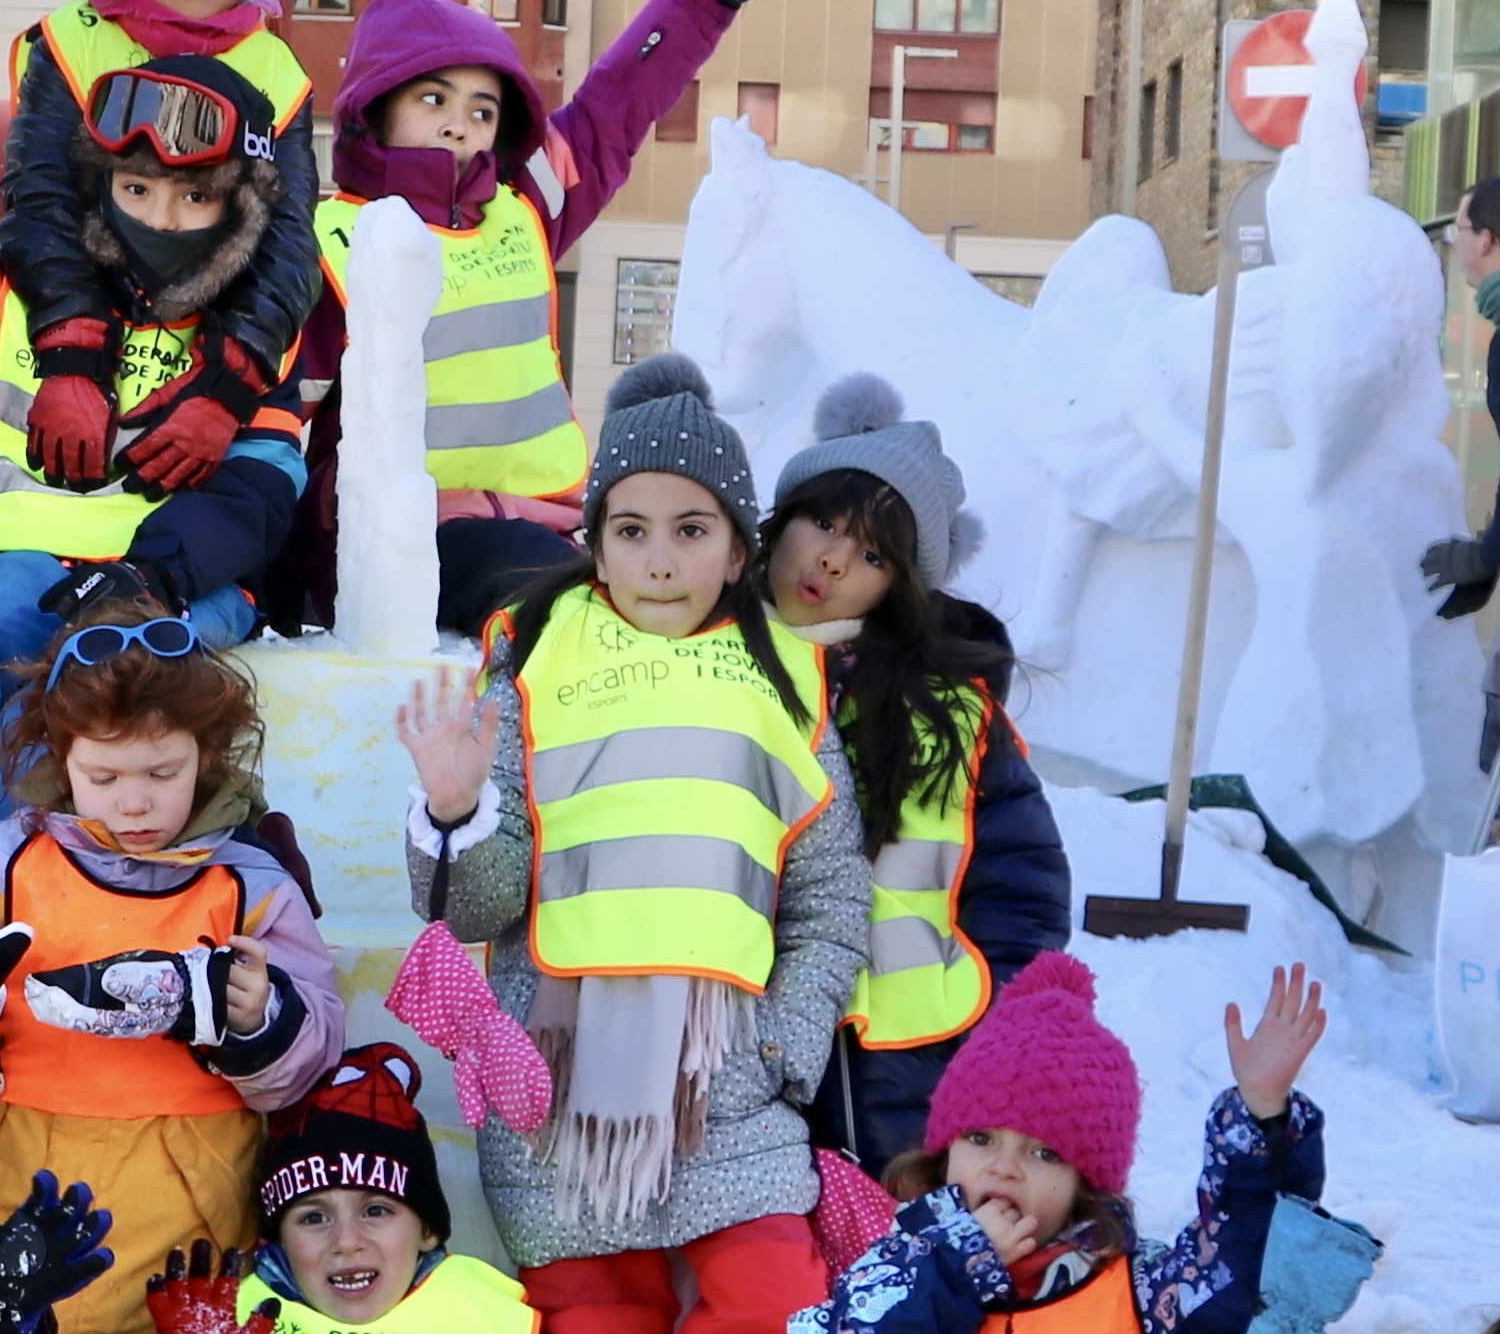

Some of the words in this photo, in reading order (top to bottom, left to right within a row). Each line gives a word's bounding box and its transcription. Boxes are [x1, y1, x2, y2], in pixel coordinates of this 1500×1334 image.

[675, 647, 705, 660] DE
[556, 655, 671, 707] encamp
[587, 694, 629, 712] ESPORTS
[260, 1152, 409, 1217] SPIDER-MAN
